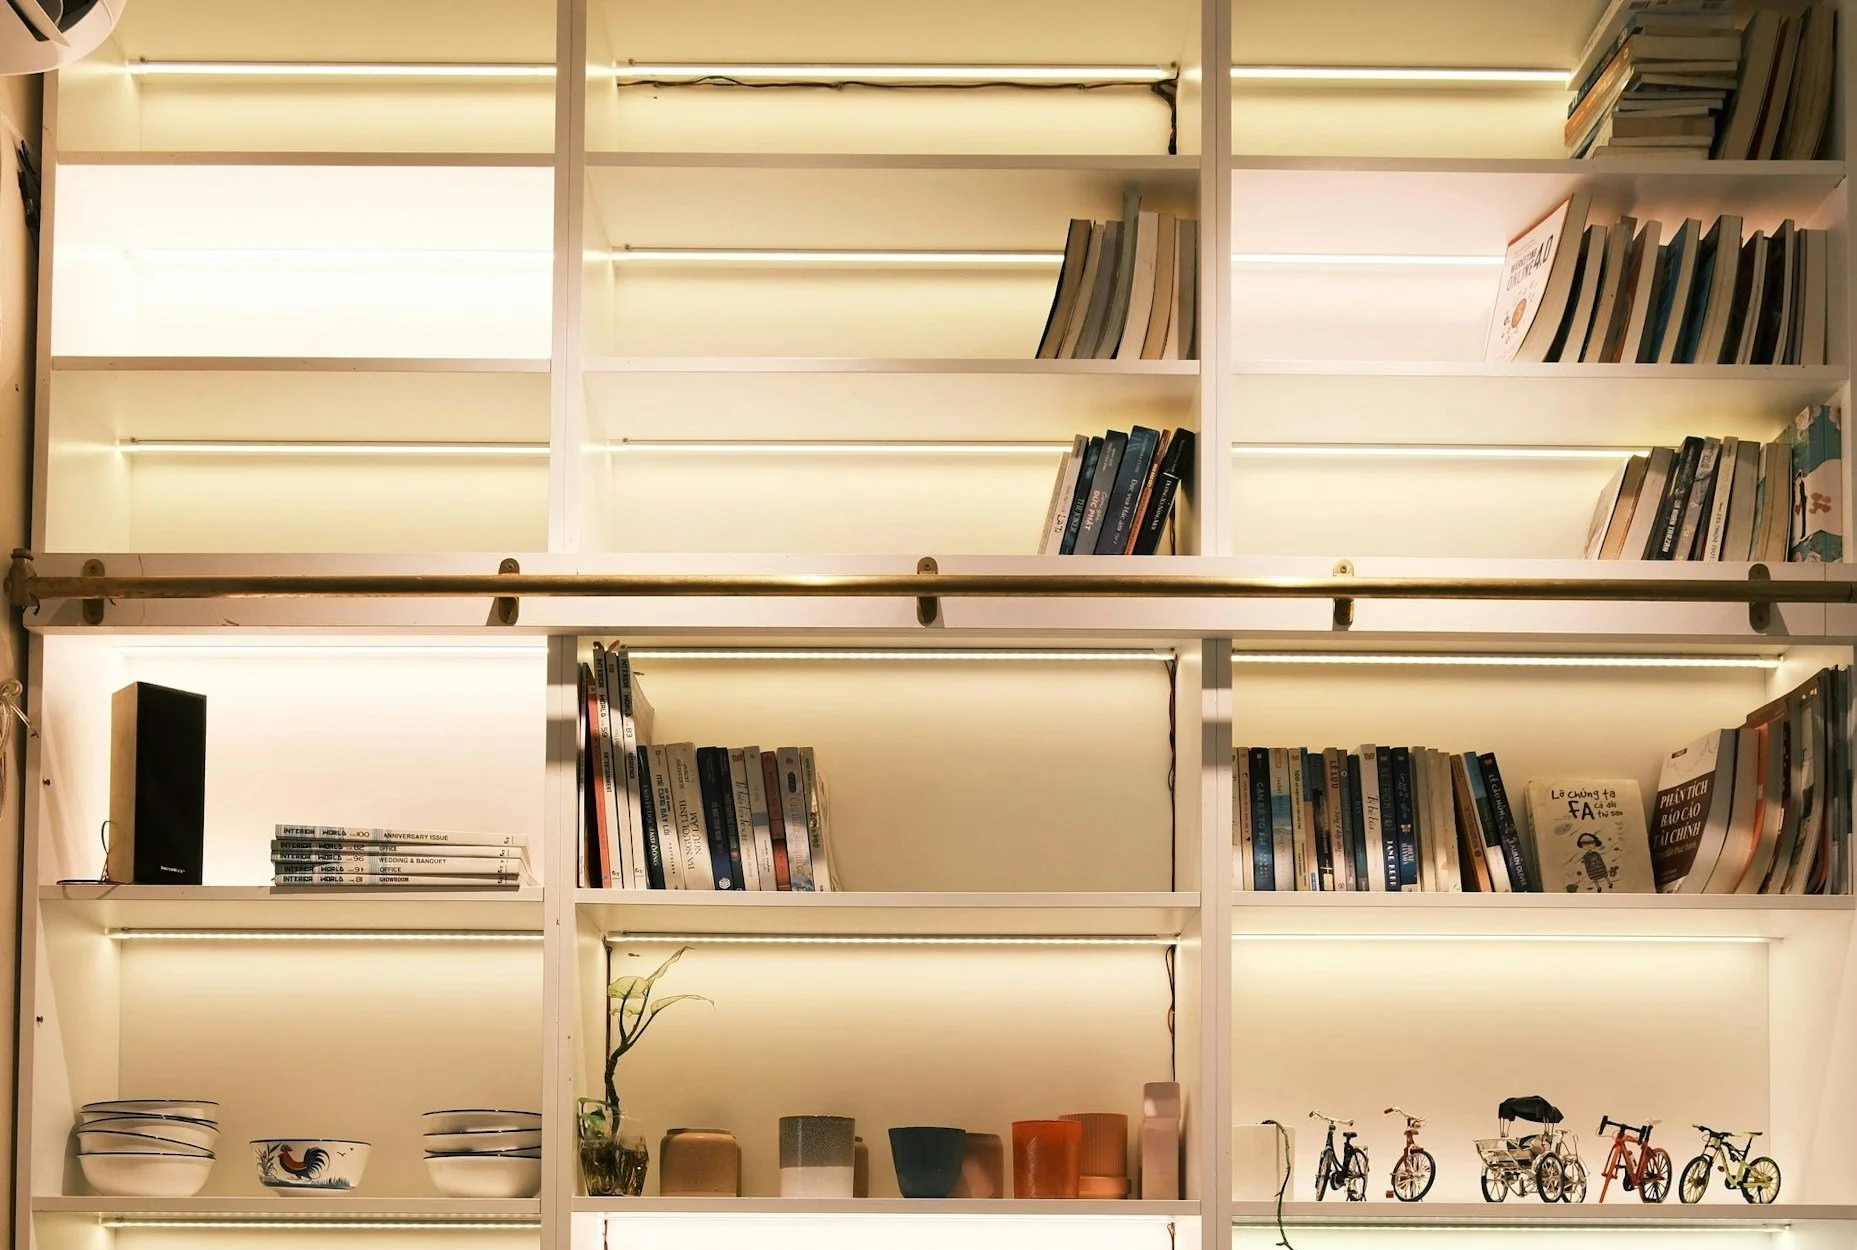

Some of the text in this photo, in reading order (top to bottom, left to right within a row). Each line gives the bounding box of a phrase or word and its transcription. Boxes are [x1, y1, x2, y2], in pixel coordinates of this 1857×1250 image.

[1534, 234, 1553, 268] 4.0
[1070, 498, 1084, 533] THE JOKER
[1085, 490, 1101, 531] ĐỨC PHẬT
[1662, 526, 1675, 553] TARZAN
[1330, 760, 1337, 770] LÊ
[1567, 787, 1599, 800] chúng
[1602, 789, 1616, 800] ta
[1660, 779, 1708, 808] PHÂN TÍCH
[679, 800, 688, 824] LÍNH
[690, 812, 699, 832] LÂM
[1568, 800, 1595, 820] FA
[1660, 801, 1701, 827] BÁO CÁO
[284, 827, 315, 835] INTERIOR
[323, 828, 347, 836] WORLD
[383, 832, 429, 841] ANNIVERSARY
[682, 825, 693, 855] NGƯỜI
[1653, 820, 1701, 849] TÀI CHÍNH
[1387, 840, 1395, 862] JANE
[1516, 865, 1527, 887] OLIVER
